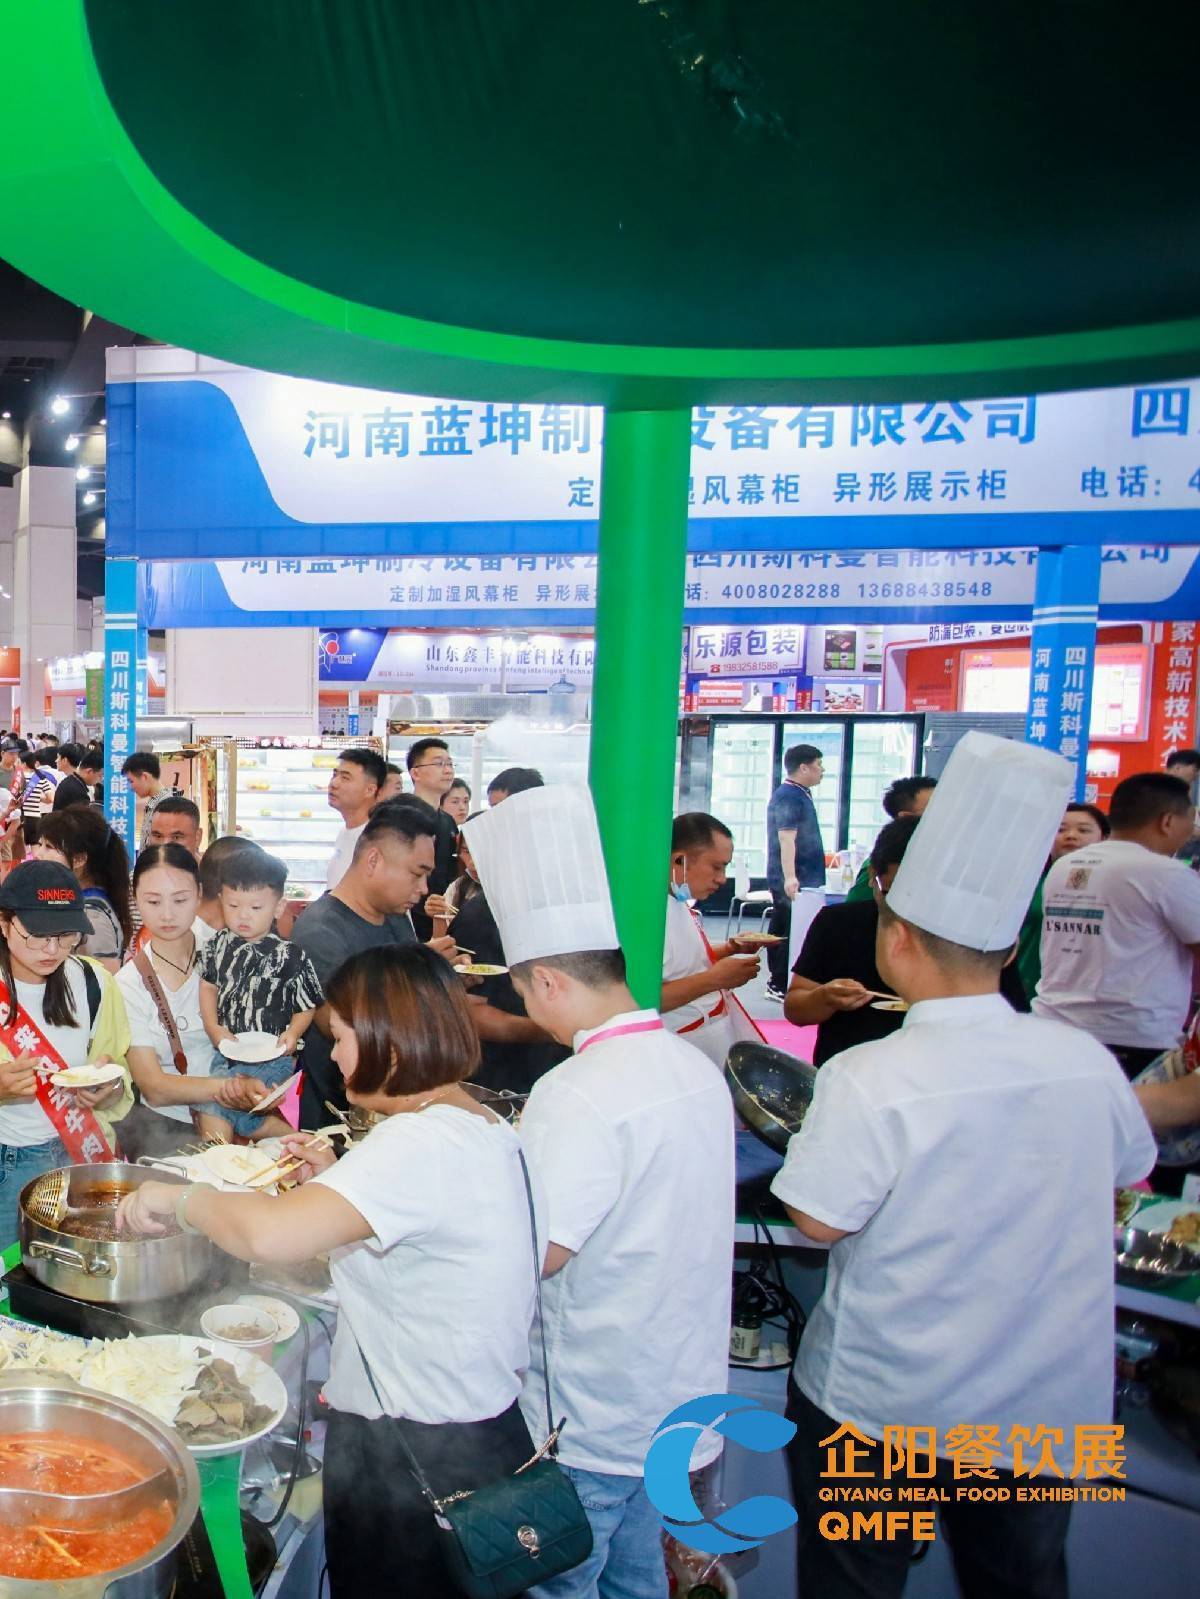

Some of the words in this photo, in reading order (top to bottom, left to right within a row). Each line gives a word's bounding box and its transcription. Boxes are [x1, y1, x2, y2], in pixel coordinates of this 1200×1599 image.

[1132, 388, 1200, 439] 四
[832, 468, 1007, 503] 异形展示柜
[1080, 465, 1161, 498] 电话：
[389, 584, 520, 603] 定制加湿风幕柜
[536, 583, 597, 602] 异形展
[721, 583, 841, 600] 4008028288
[857, 581, 993, 600] 13688438548
[695, 627, 797, 659] 乐源包装
[1029, 647, 1052, 748] 河南蓝坤
[108, 650, 131, 842] 四川斯科曼智能科技
